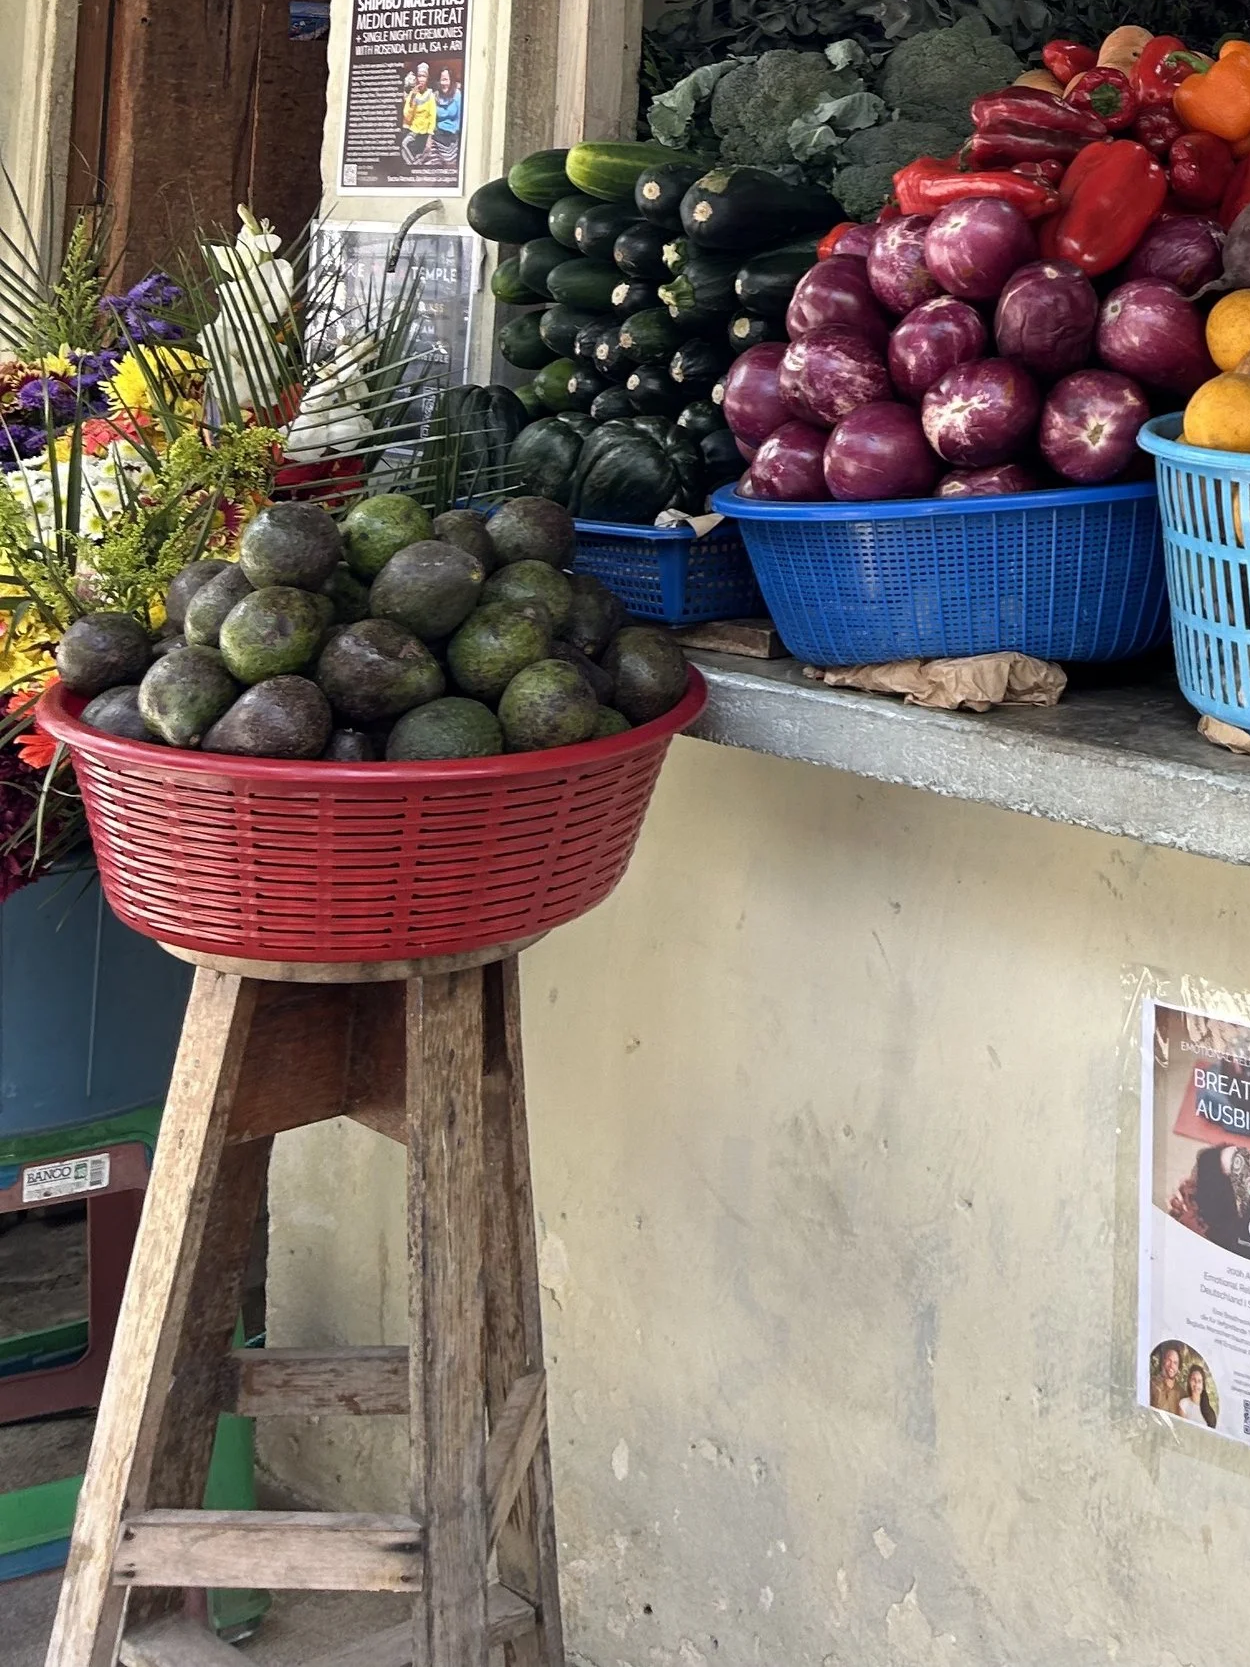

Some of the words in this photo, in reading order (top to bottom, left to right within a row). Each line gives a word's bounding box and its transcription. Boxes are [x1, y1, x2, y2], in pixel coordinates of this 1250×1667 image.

[356, 11, 410, 30] MEDICINE
[412, 7, 464, 27] RETREAT
[363, 31, 388, 43] SINGLE
[390, 29, 413, 41] NIGHT
[414, 26, 463, 40] CEREMONIES
[355, 45, 373, 55] WITH
[27, 1166, 72, 1184] BANCO
[1203, 1271, 1238, 1291] Emotional
[1200, 1284, 1243, 1306] Deutschland
